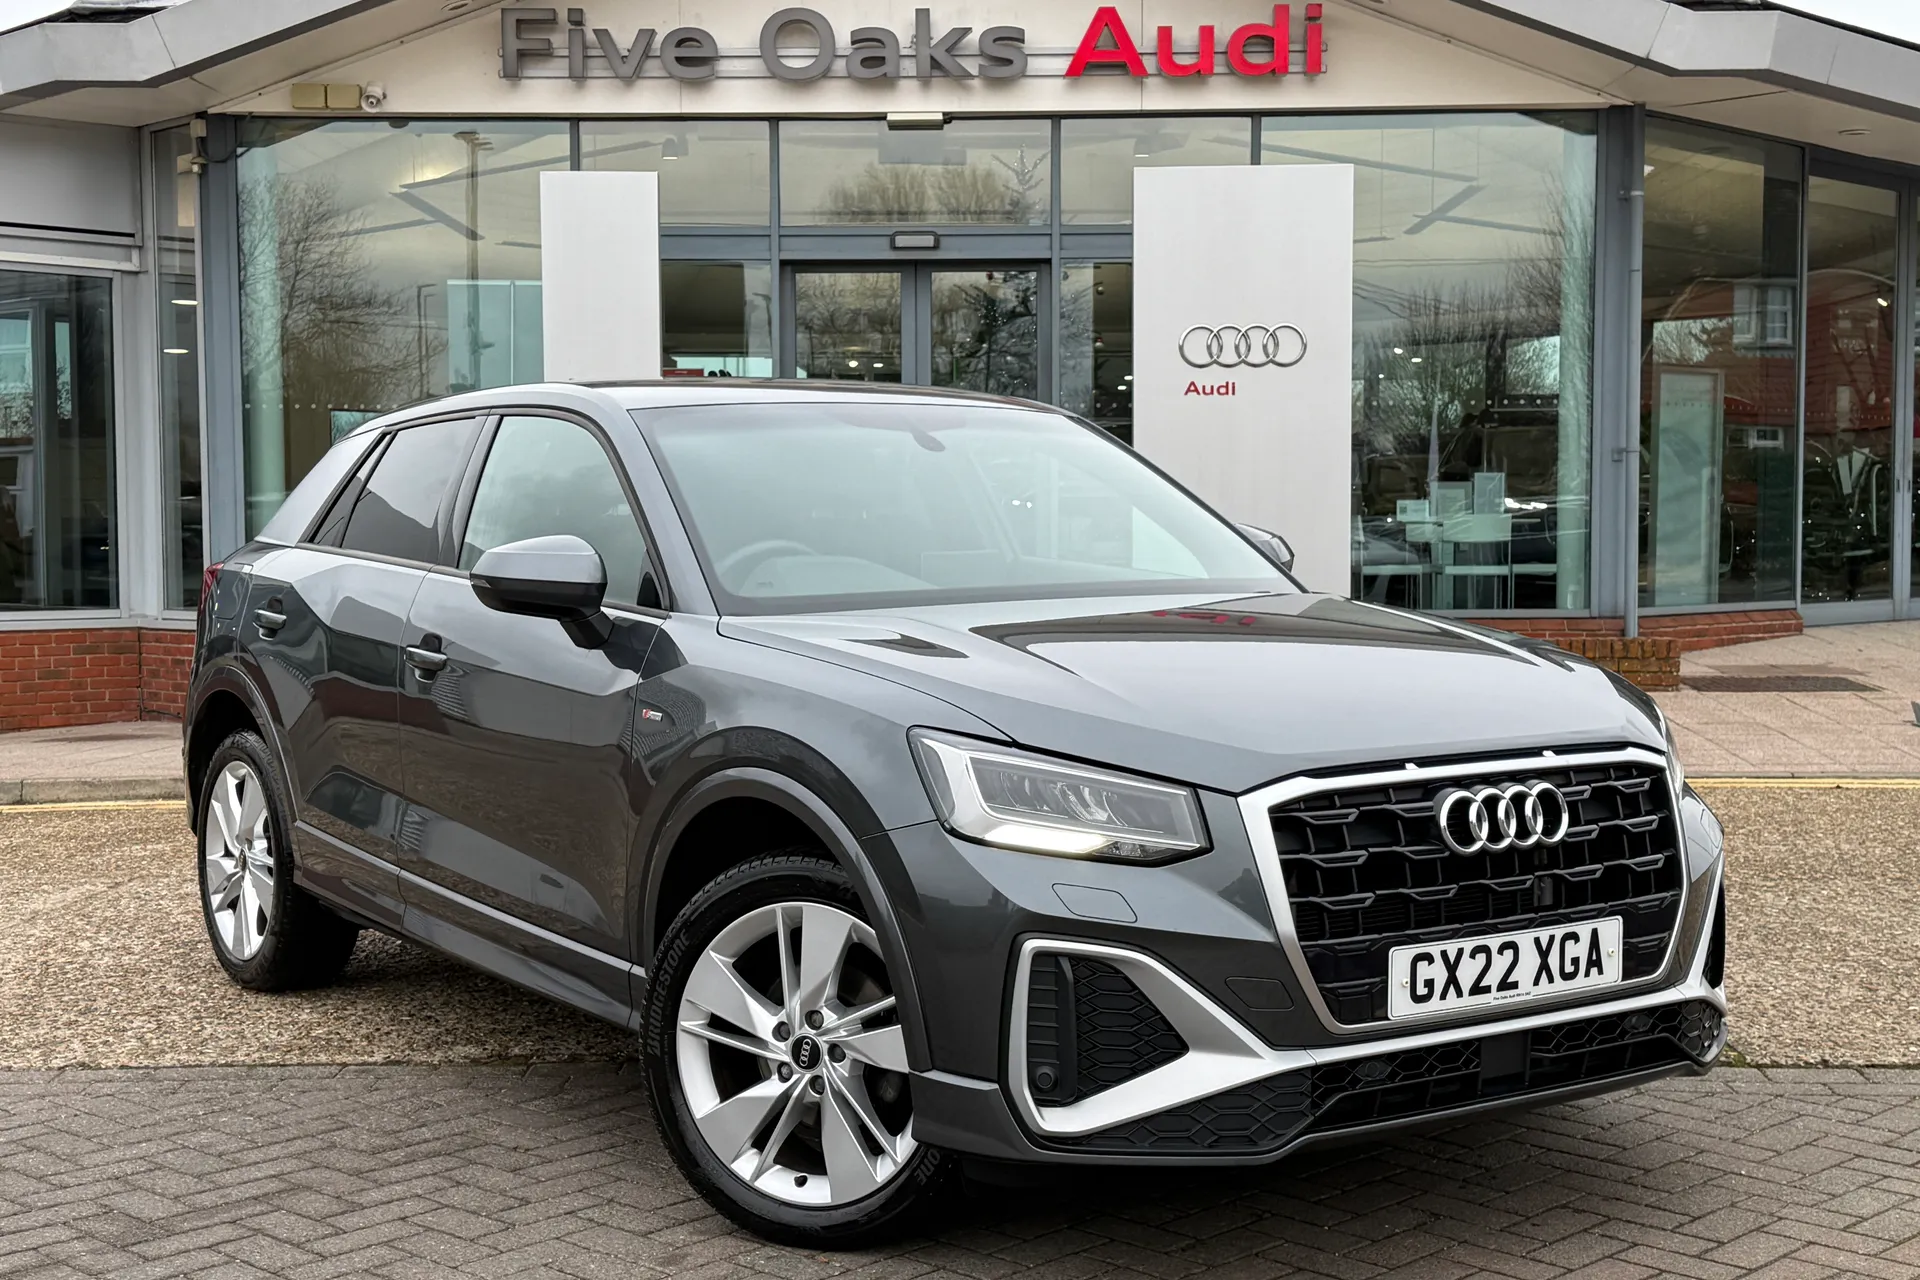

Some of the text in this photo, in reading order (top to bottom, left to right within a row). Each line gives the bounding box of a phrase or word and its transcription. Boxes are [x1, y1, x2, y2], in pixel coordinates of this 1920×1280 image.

[500, 3, 1323, 82] Five Oaks Audi
[1184, 381, 1236, 396] Audi
[646, 928, 691, 1057] BRIDGESTONE
[1409, 927, 1604, 1004] GX22 XGA
